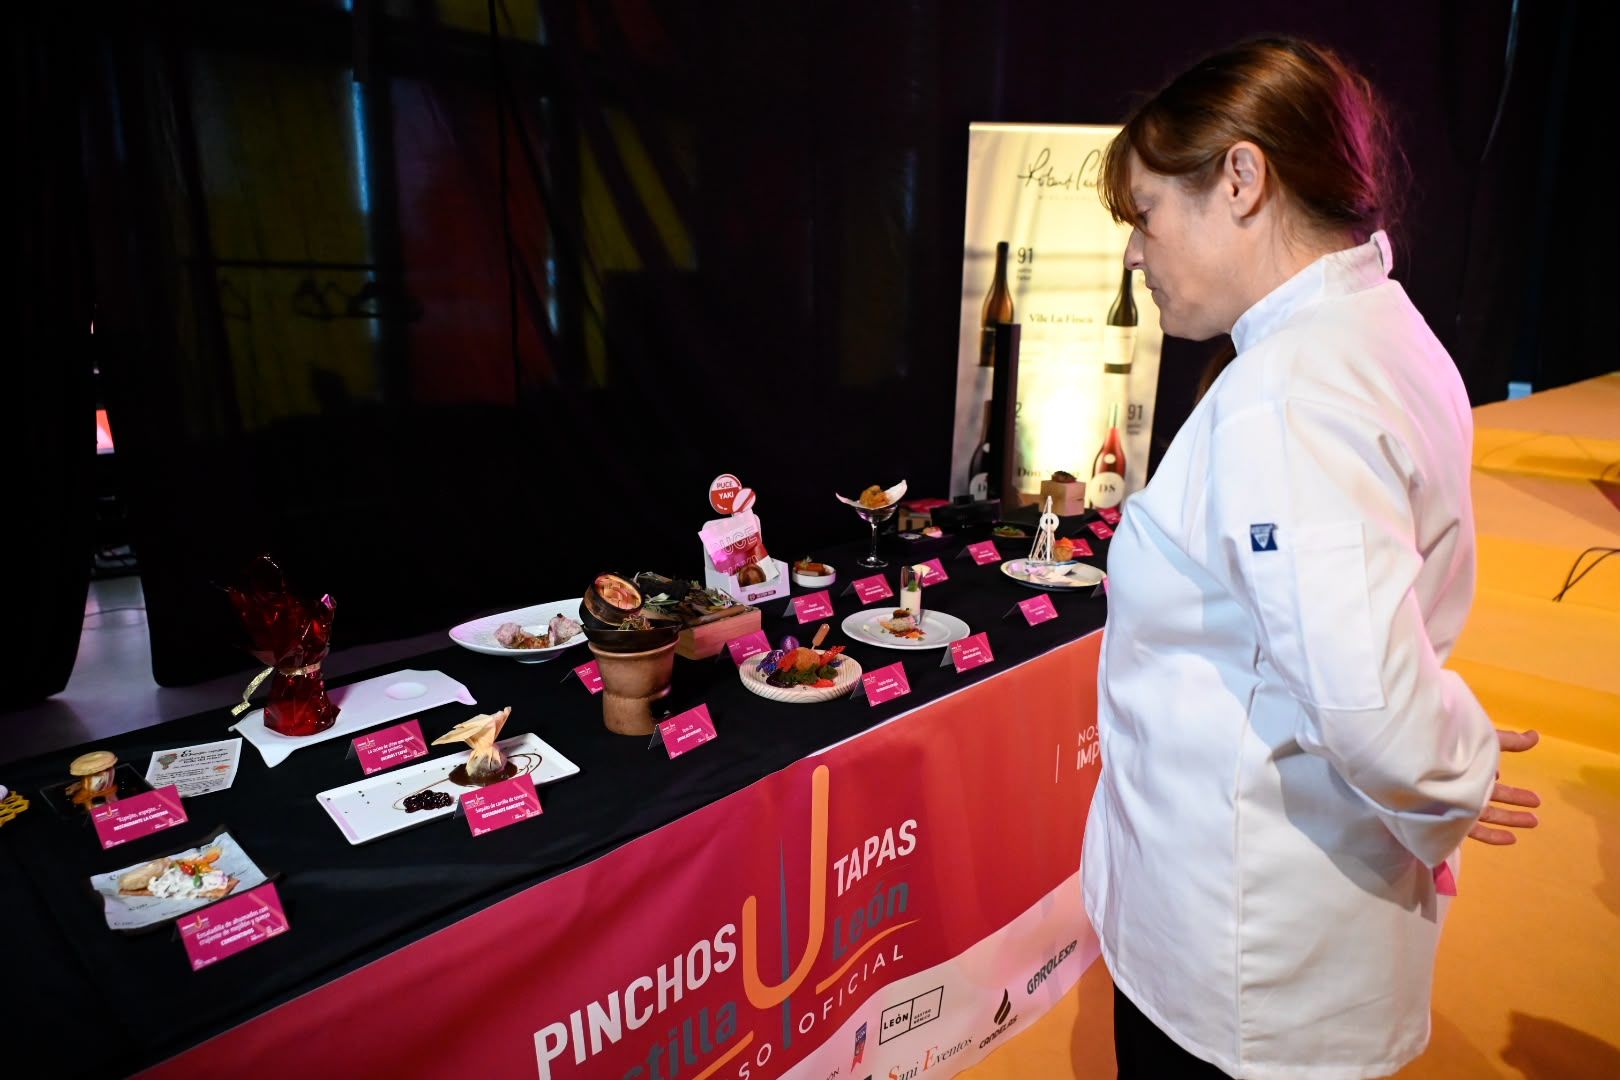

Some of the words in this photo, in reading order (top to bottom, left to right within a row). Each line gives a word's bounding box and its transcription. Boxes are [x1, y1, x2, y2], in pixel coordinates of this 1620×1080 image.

[1017, 247, 1033, 264] 91
[1015, 401, 1022, 418] 2
[1127, 404, 1143, 421] 91
[719, 491, 734, 500] YAKI
[1076, 740, 1100, 770] IMP
[533, 923, 737, 1080] PINCHOS
[833, 818, 918, 897] TAPAS
[624, 1001, 738, 1080] tilla
[832, 880, 910, 961] León
[738, 1043, 772, 1080] SO
[798, 944, 904, 1034] OFICIAL
[883, 1013, 909, 1030] LEÓN
